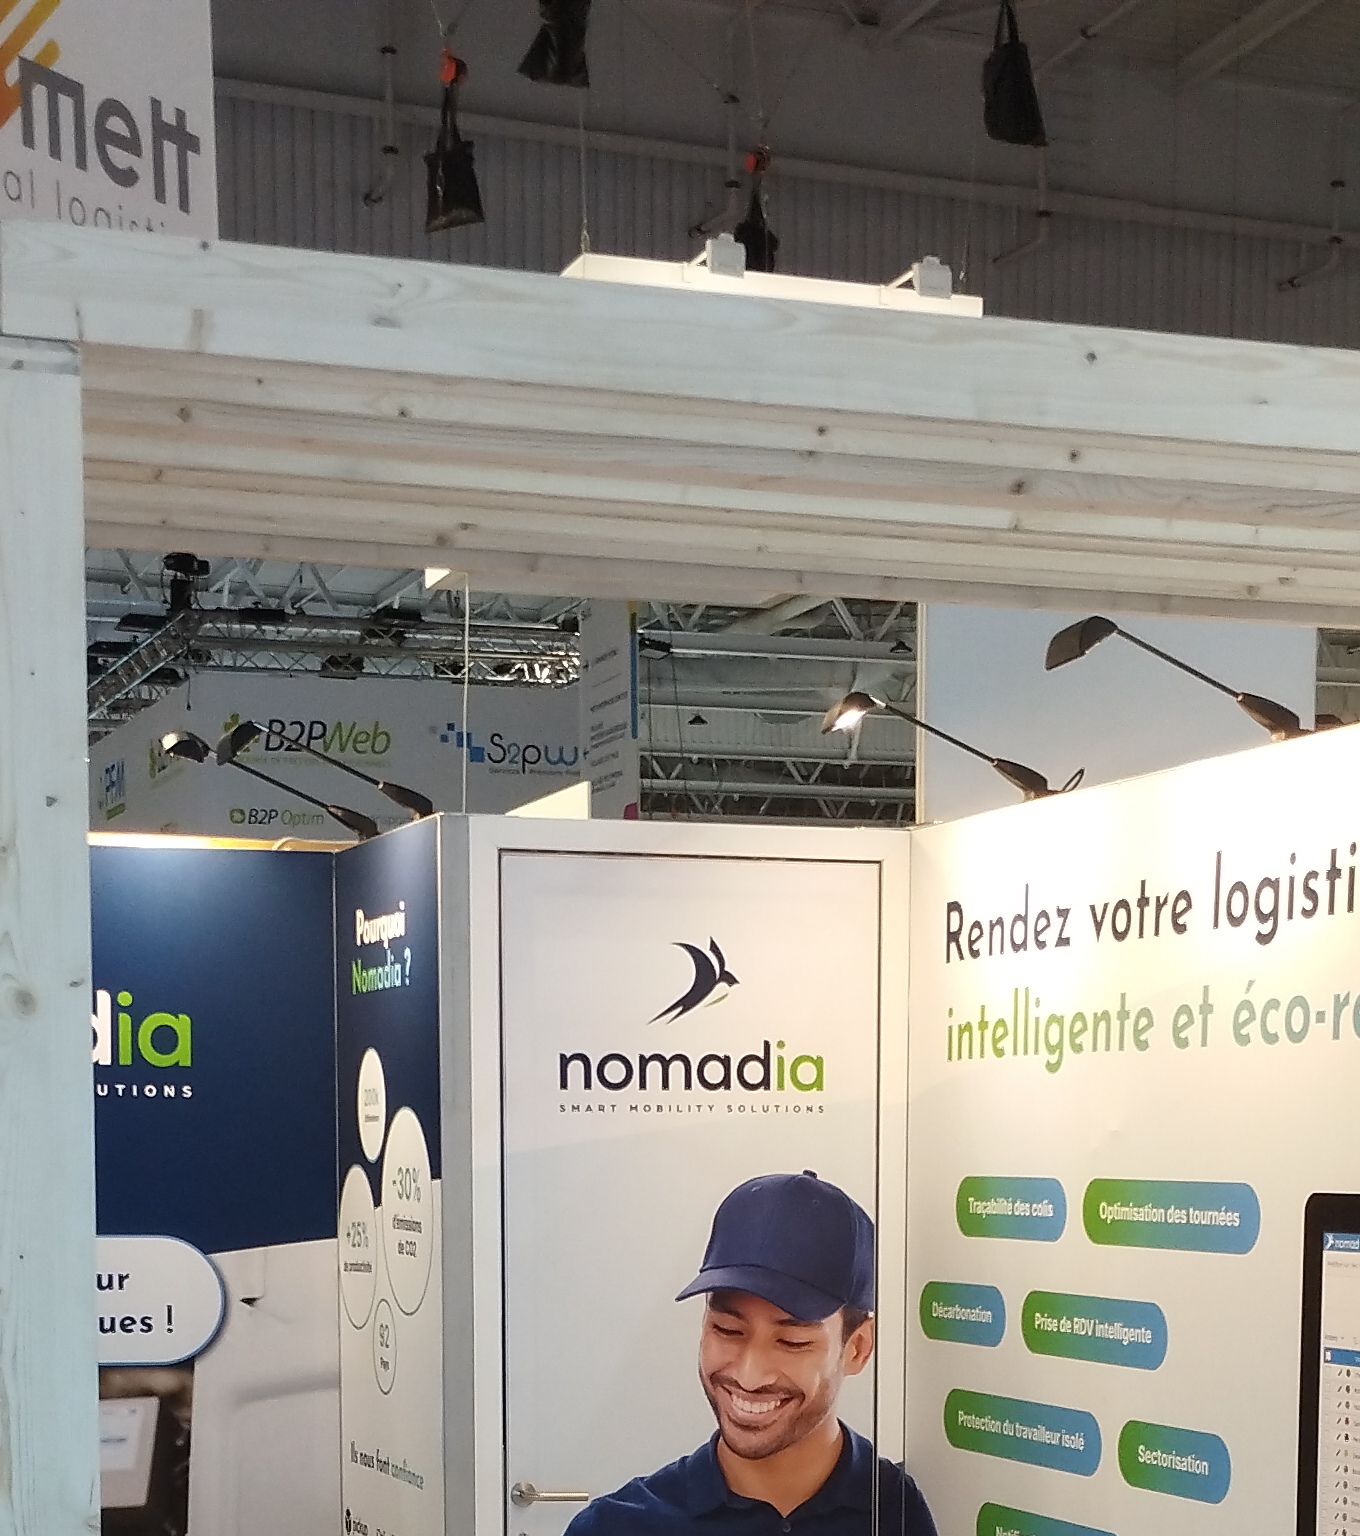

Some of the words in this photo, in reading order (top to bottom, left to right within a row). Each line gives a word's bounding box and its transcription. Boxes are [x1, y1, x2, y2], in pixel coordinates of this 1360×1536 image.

[264, 719, 392, 755] B2PWeb
[487, 733, 579, 774] S2pw
[248, 808, 279, 826] B2P
[355, 901, 407, 949] Pourquoi
[945, 883, 1072, 964] Rendez
[1089, 878, 1193, 944] votre
[351, 948, 402, 996] Nomadia
[945, 986, 1152, 1075] intelligente
[1172, 983, 1214, 1050] et
[559, 1039, 825, 1093] nomadia
[96, 1083, 193, 1098] UTIONS
[559, 1104, 618, 1114] SMART
[629, 1104, 716, 1114] MOBILITY
[726, 1104, 825, 1114] SOLUTIONS
[968, 1198, 1013, 1219] Traçabilité
[1013, 1200, 1030, 1217] des
[1031, 1199, 1054, 1218] colis
[1099, 1201, 1164, 1224] Optimisation
[1166, 1204, 1187, 1224] des
[1189, 1205, 1240, 1228] tournées
[96, 1272, 130, 1291] ur
[98, 1315, 154, 1334] ues
[931, 1300, 993, 1325] Décarbonation
[1034, 1313, 1058, 1334] Prise
[1060, 1316, 1072, 1334] de
[1073, 1318, 1094, 1336] RDV
[1095, 1319, 1152, 1345] intelligente
[958, 1410, 1002, 1434] Protection
[1002, 1418, 1014, 1436] du
[1015, 1420, 1060, 1447] travailleur
[1061, 1427, 1085, 1452] isolé
[1138, 1445, 1209, 1477] Sectorisation
